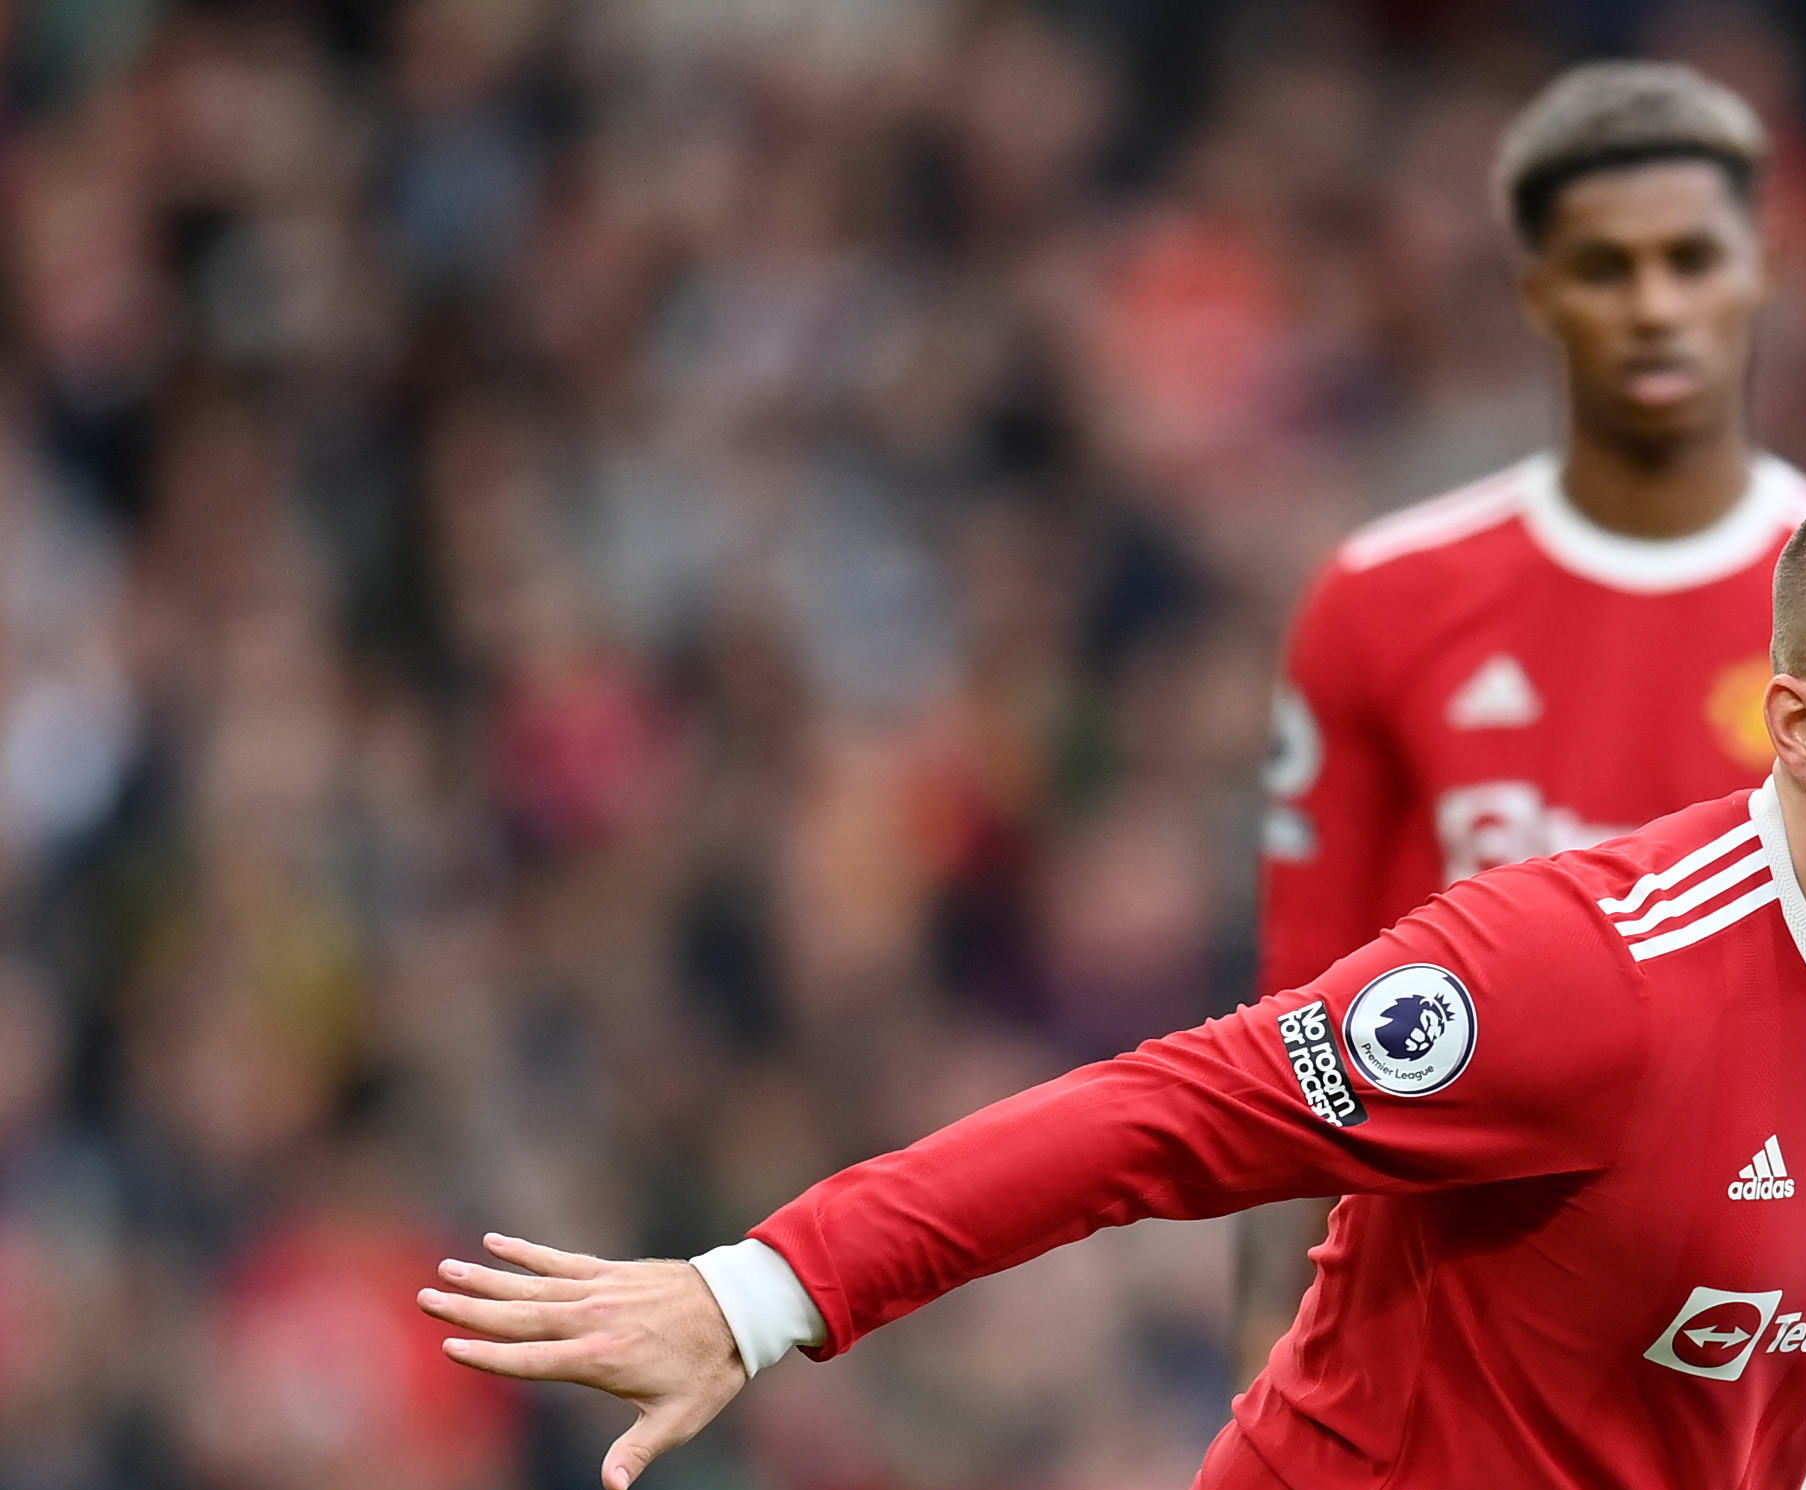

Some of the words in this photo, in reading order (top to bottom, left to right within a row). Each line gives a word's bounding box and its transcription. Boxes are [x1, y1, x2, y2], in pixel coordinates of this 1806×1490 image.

[1300, 1000, 1327, 1041] No
[1310, 1042, 1356, 1118] room
[1360, 1042, 1394, 1076] Premier
[1395, 1065, 1435, 1082] League
[1727, 1176, 1796, 1201] adidas
